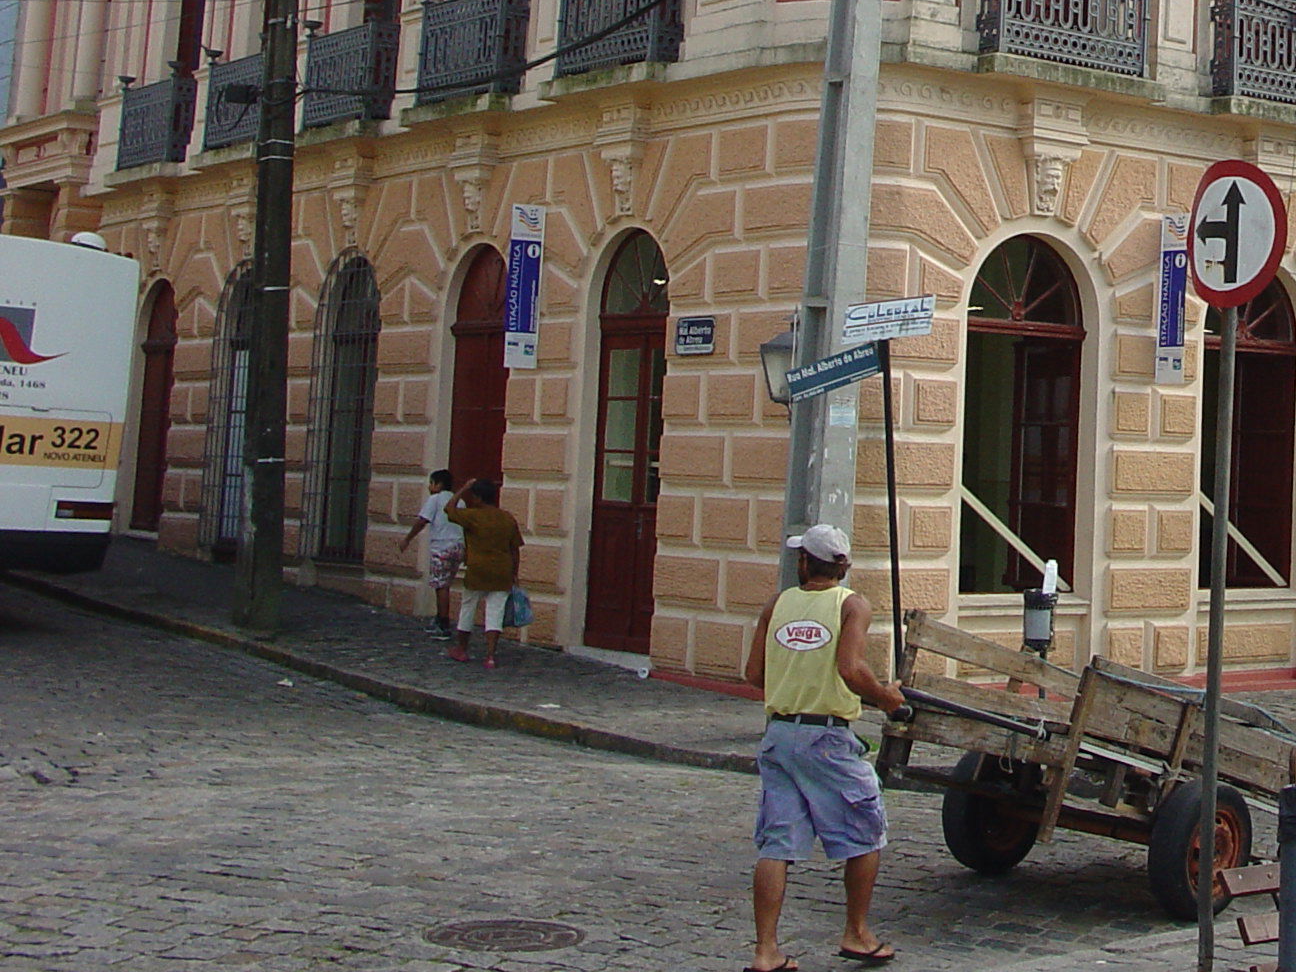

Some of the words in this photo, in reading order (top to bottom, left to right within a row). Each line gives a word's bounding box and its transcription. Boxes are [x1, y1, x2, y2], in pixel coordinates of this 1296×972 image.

[51, 426, 100, 450] 322
[43, 452, 70, 462] NOVO
[71, 453, 106, 463] ATENEU
